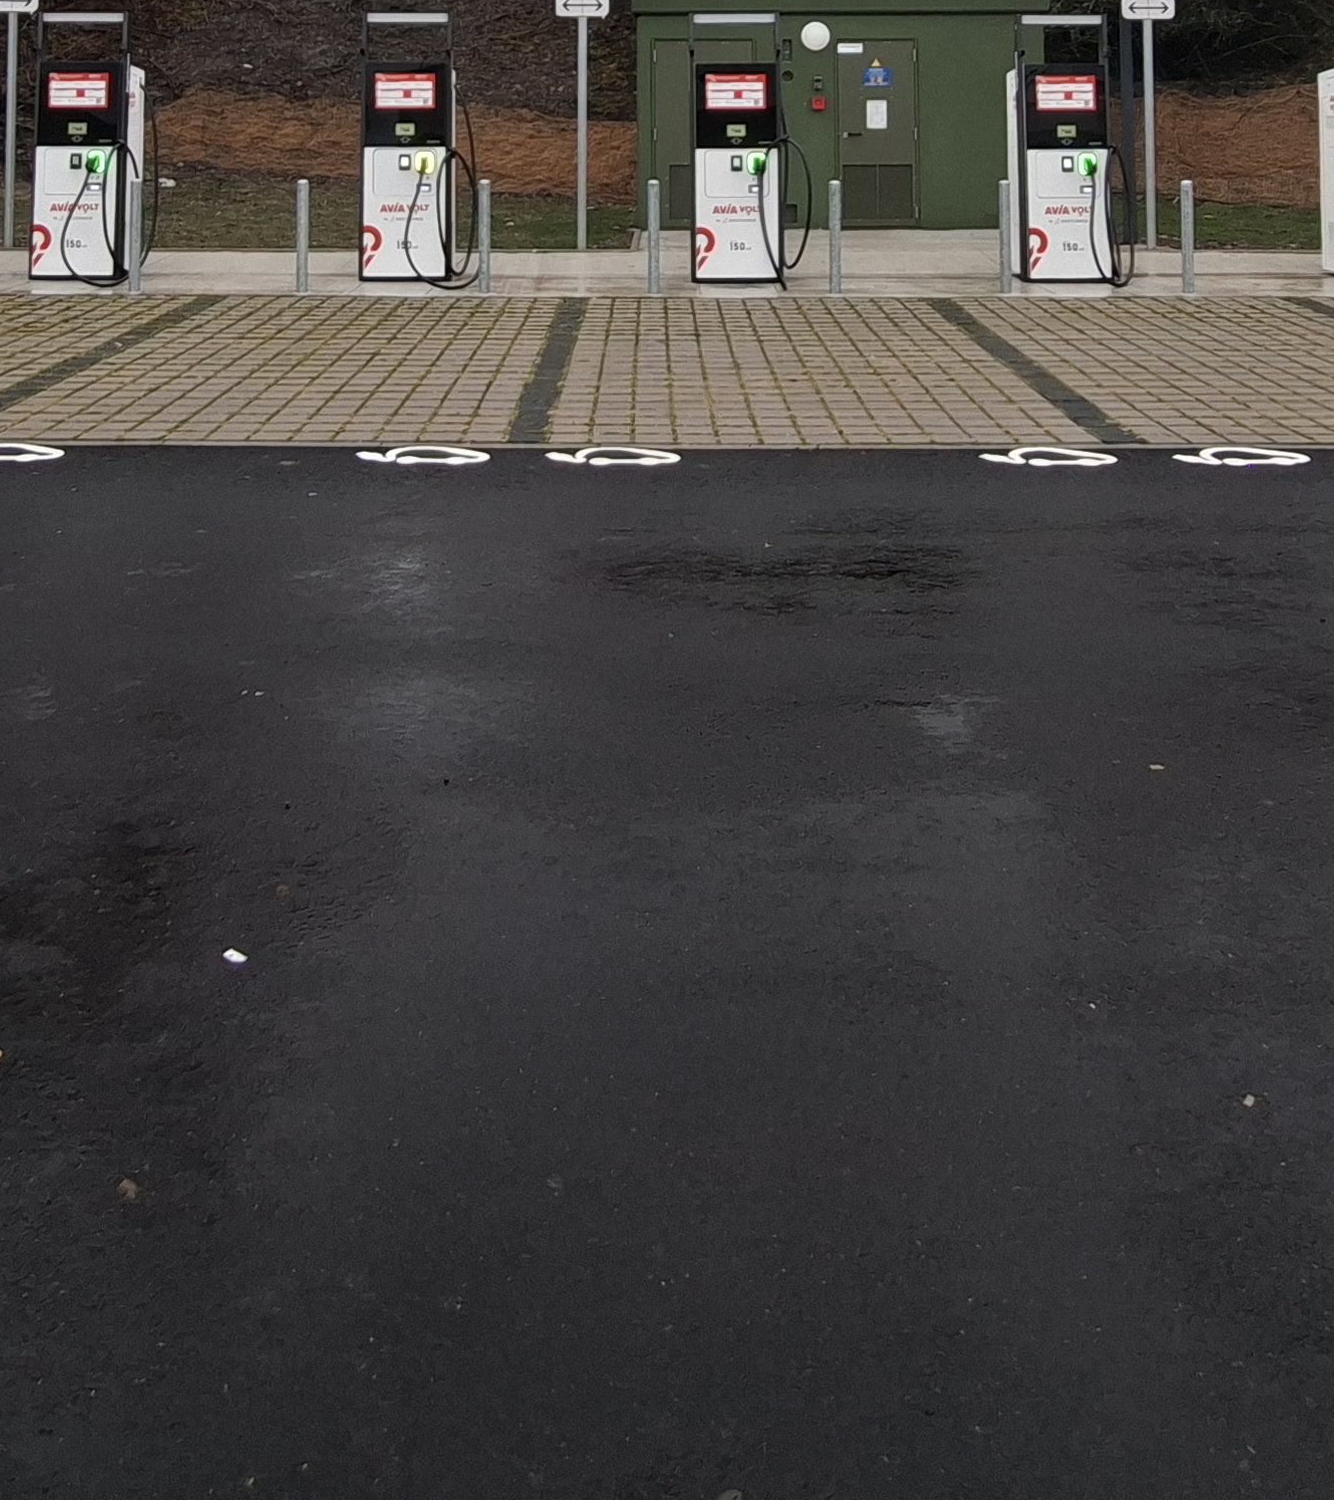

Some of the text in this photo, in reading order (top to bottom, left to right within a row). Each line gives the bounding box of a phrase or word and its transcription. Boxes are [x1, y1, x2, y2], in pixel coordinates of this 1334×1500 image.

[739, 205, 760, 216] VOL
[1071, 206, 1091, 217] VOL
[66, 239, 82, 248] 150
[730, 241, 745, 251] 150
[1062, 242, 1078, 251] 150
